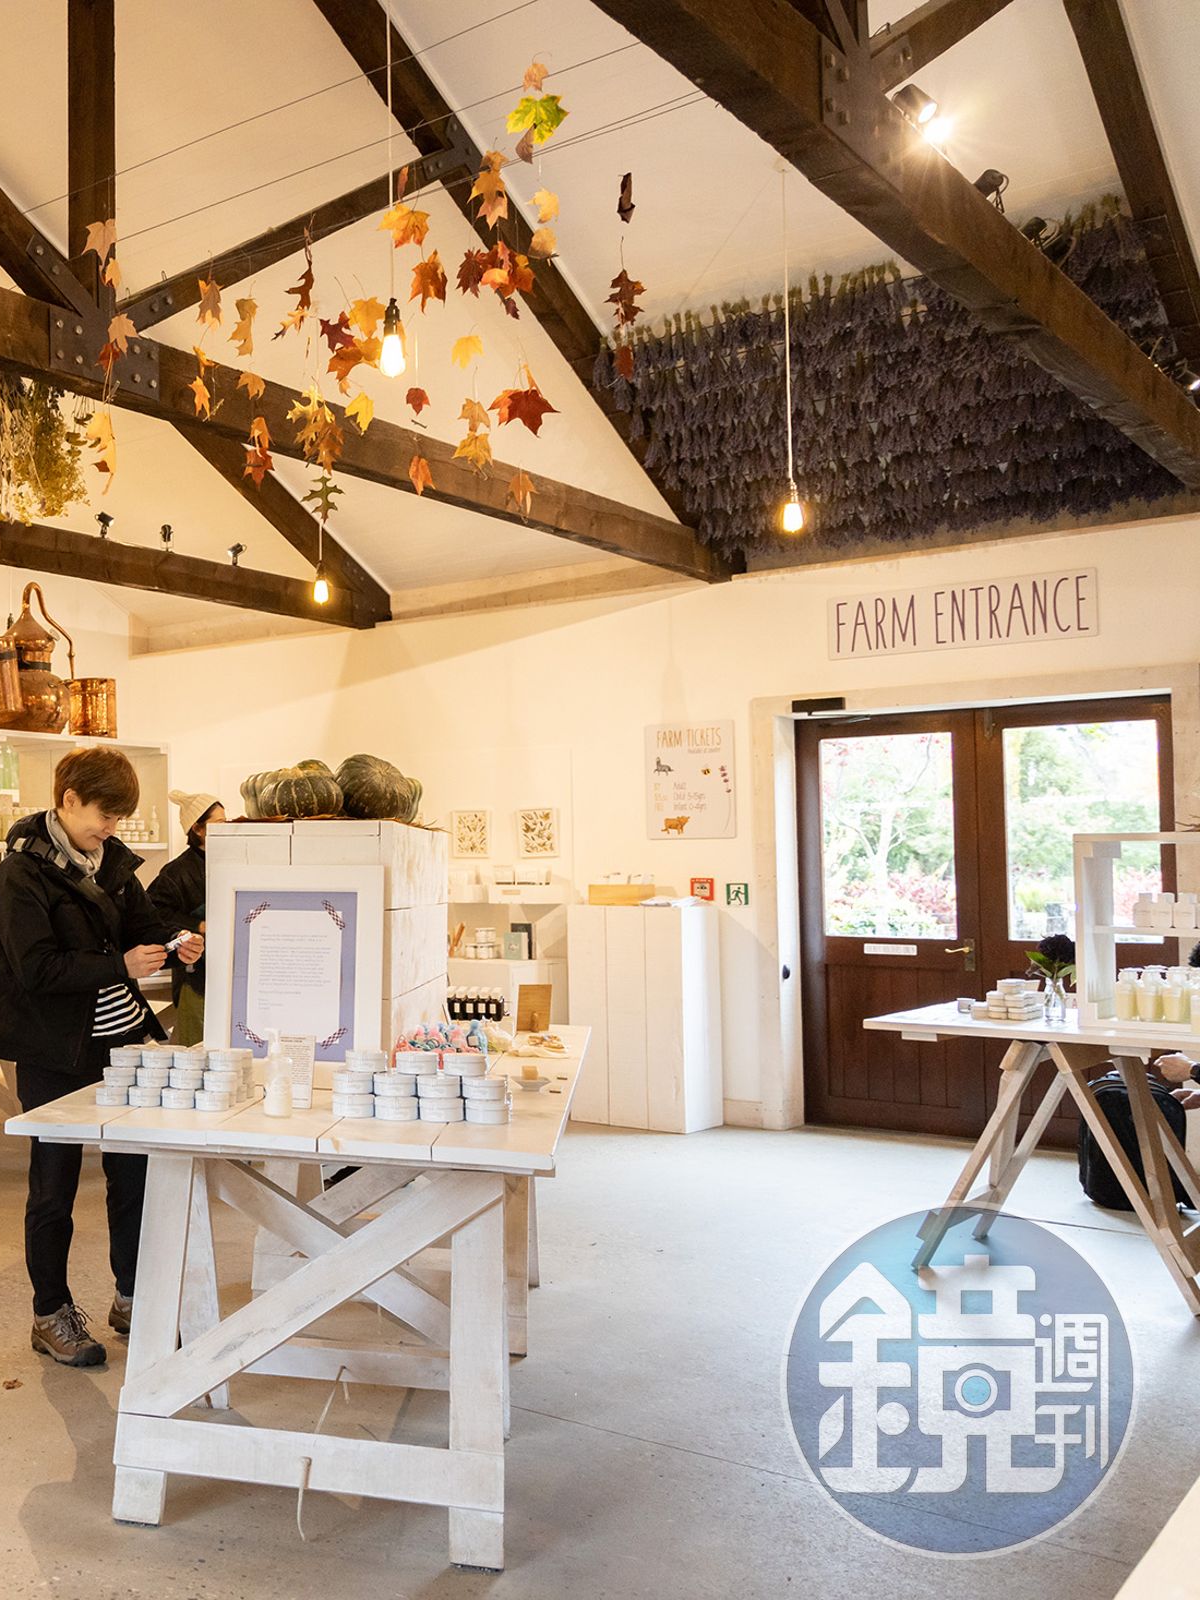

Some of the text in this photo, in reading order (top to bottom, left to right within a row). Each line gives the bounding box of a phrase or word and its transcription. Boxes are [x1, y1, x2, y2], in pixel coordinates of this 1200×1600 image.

[836, 575, 1090, 653] FARM ENTRANCE
[657, 727, 722, 748] FARM TICKETS
